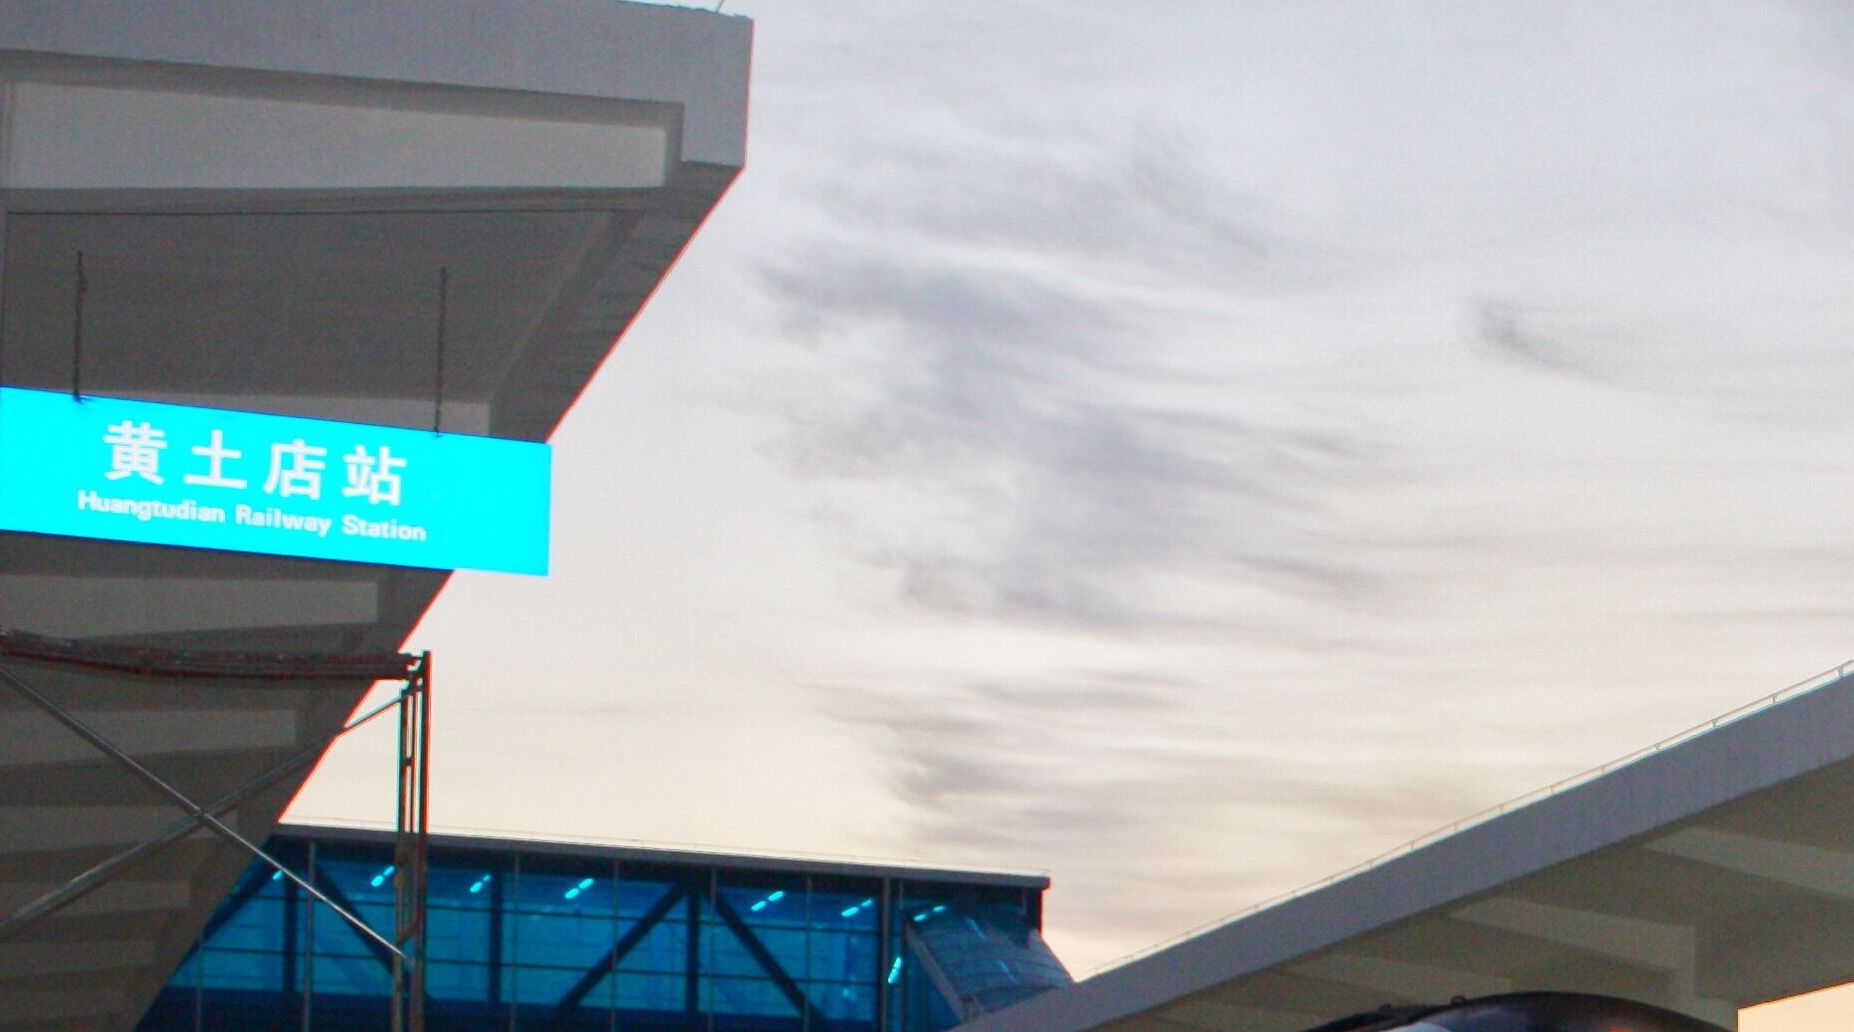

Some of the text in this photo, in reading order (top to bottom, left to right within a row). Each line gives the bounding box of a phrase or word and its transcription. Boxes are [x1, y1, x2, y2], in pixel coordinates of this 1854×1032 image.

[103, 419, 408, 507] 黄土店站
[77, 489, 427, 542] Huangtudian Railway Station
